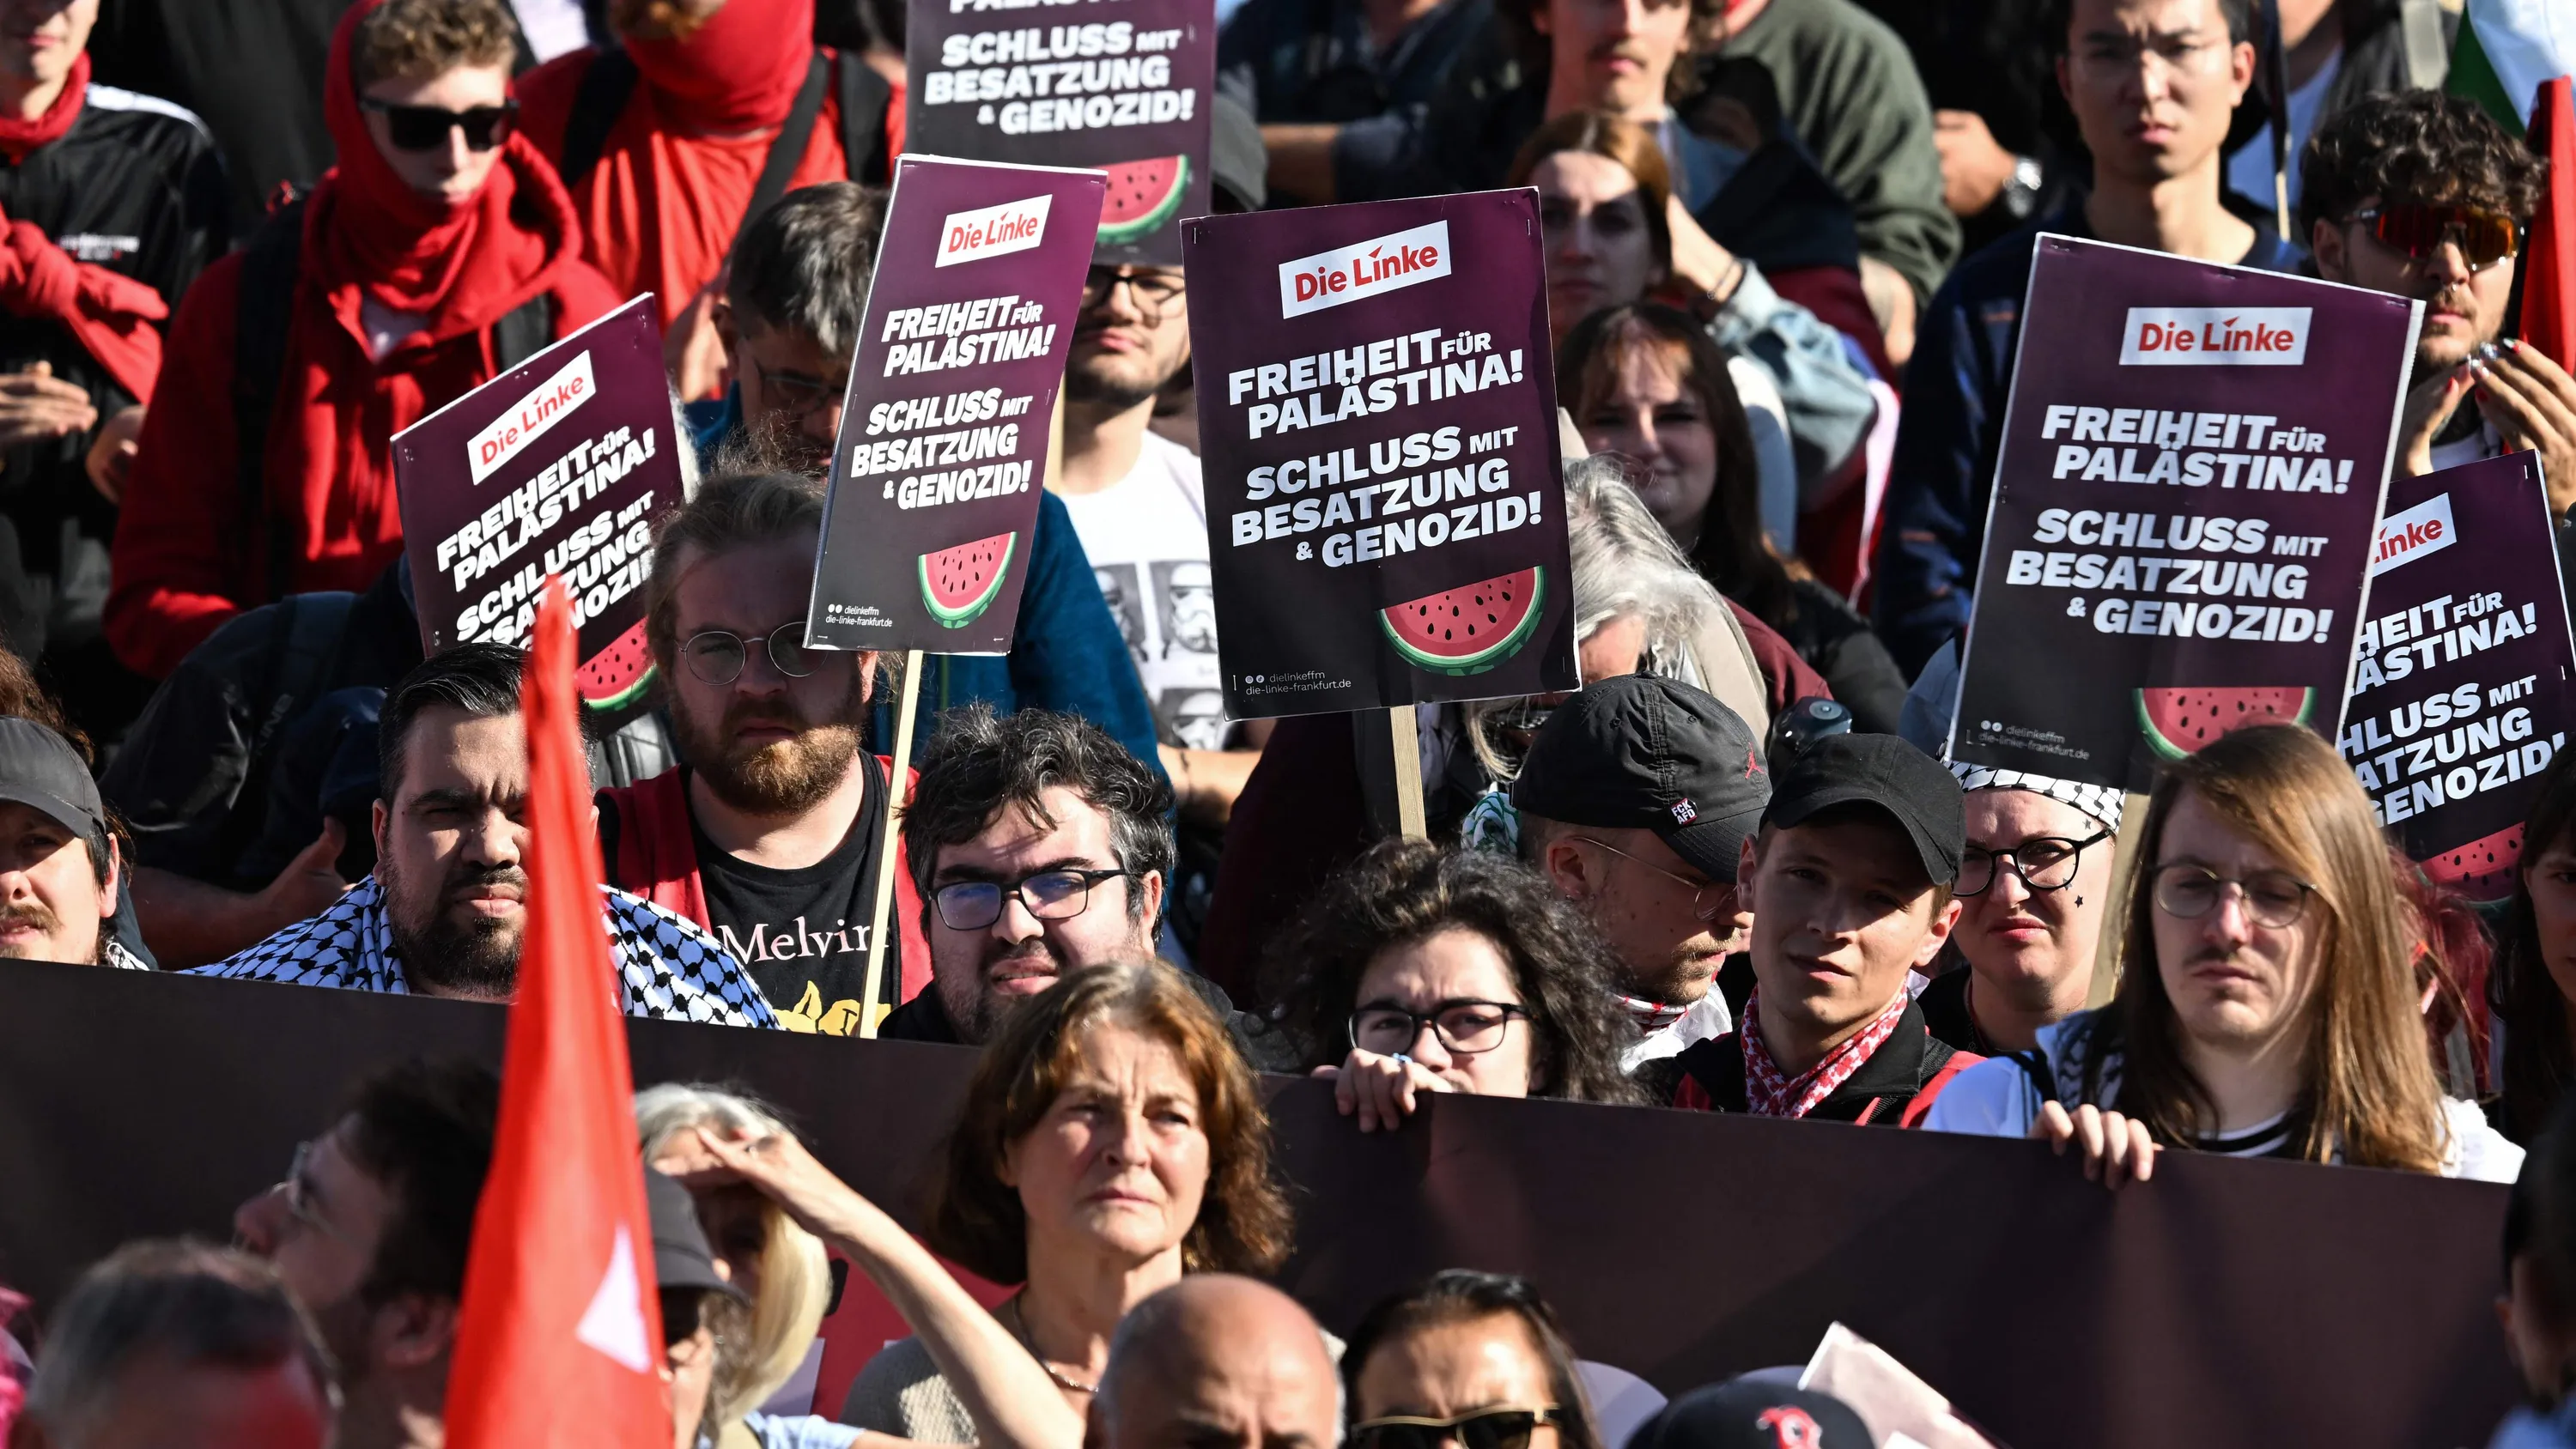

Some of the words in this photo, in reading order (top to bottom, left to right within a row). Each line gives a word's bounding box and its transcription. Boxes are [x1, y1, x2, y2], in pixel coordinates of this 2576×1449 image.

[941, 21, 1133, 67] SCHLUSS
[1136, 29, 1183, 52] MIT
[925, 55, 1171, 106] BESATZUNG
[976, 105, 995, 125] &
[999, 88, 1195, 135] GENOZID!
[948, 222, 981, 252] Die
[986, 211, 1037, 246] Linke
[1295, 267, 1346, 302] Die
[1353, 244, 1438, 287] Linke
[881, 295, 1019, 342] FREIHEIT
[1012, 300, 1043, 326] FÜR
[2138, 323, 2195, 352] Die
[2202, 316, 2293, 352] Linke
[884, 324, 1056, 377] PALÄSTINA!
[1229, 328, 1442, 405] FREIHEIT
[1440, 330, 1492, 361] FÜR
[481, 423, 518, 465] Die
[522, 375, 583, 429] Linke
[866, 387, 1002, 436] SCHLUSS
[999, 396, 1033, 417] MIT
[1249, 349, 1523, 440] PALÄSTINA!
[851, 422, 1018, 478] BESATZUNG
[2041, 404, 2276, 451] FREIHEIT
[2269, 427, 2326, 452] FÜR
[883, 480, 894, 500] &
[897, 460, 1033, 510] GENOZID!
[1246, 426, 1461, 500] SCHLUSS
[1469, 427, 1518, 454] MIT
[2052, 438, 2354, 494] PALÄSTINA!
[436, 440, 592, 572] FREIHEIT
[591, 426, 631, 464] FÜR
[454, 428, 655, 591] PALÄSTINA!
[1231, 458, 1510, 547] BESATZUNG
[1296, 541, 1313, 561] &
[1321, 490, 1542, 567] GENOZID!
[2032, 508, 2269, 555] SCHLUSS
[2271, 536, 2329, 557] MIT
[2372, 518, 2443, 564] inke
[456, 509, 612, 641] SCHLUSS
[617, 490, 655, 529] MIT
[471, 520, 651, 646] SATZUNG
[2005, 550, 2310, 600] BESATZUNG
[2066, 597, 2086, 617] &
[2093, 598, 2334, 643] GENOZID!
[2358, 594, 2452, 654] HEIT
[2453, 591, 2504, 624] FÜR
[2349, 603, 2537, 696] ÄSTINA!
[1246, 679, 1351, 695] die-linke-frankfurt.de
[1269, 670, 1325, 683] dielinkeffm
[2337, 682, 2481, 761] HLUSS
[2489, 675, 2537, 708] MIT
[2355, 707, 2531, 791] ATZUNG
[1671, 800, 1692, 816] FCK
[1677, 809, 1696, 824] AFD
